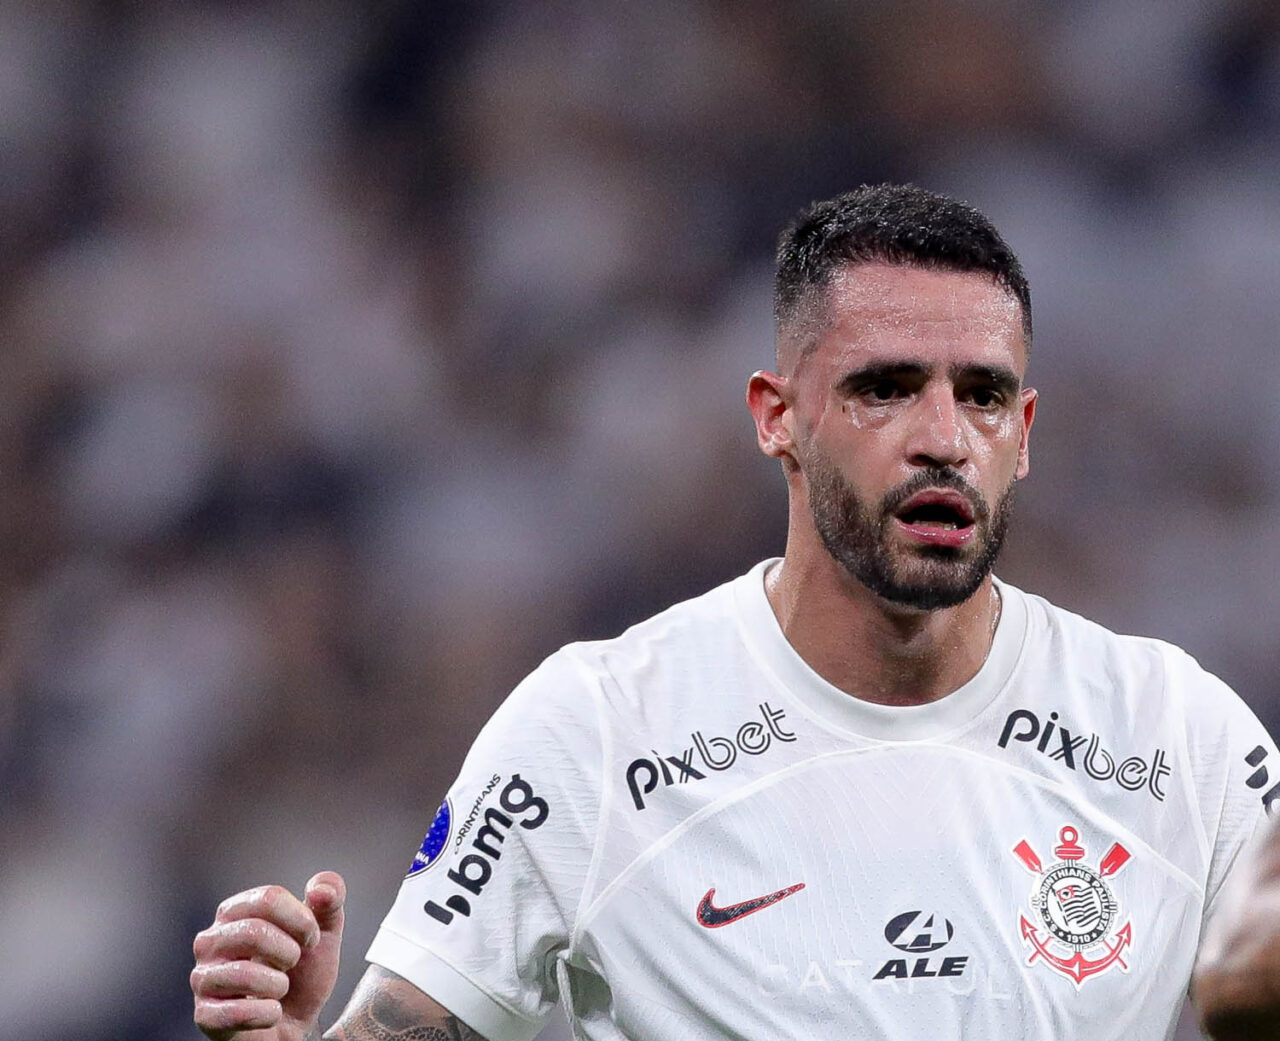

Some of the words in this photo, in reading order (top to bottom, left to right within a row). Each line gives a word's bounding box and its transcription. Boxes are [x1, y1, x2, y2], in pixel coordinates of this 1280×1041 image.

[626, 702, 797, 810] pixbet
[997, 709, 1171, 801] pixbet
[447, 773, 549, 895] bmg
[1040, 868, 1092, 909] CORINTHIANS
[1091, 880, 1110, 931] PAULISTA
[1067, 934, 1091, 942] 1910
[872, 955, 969, 980] ALE
